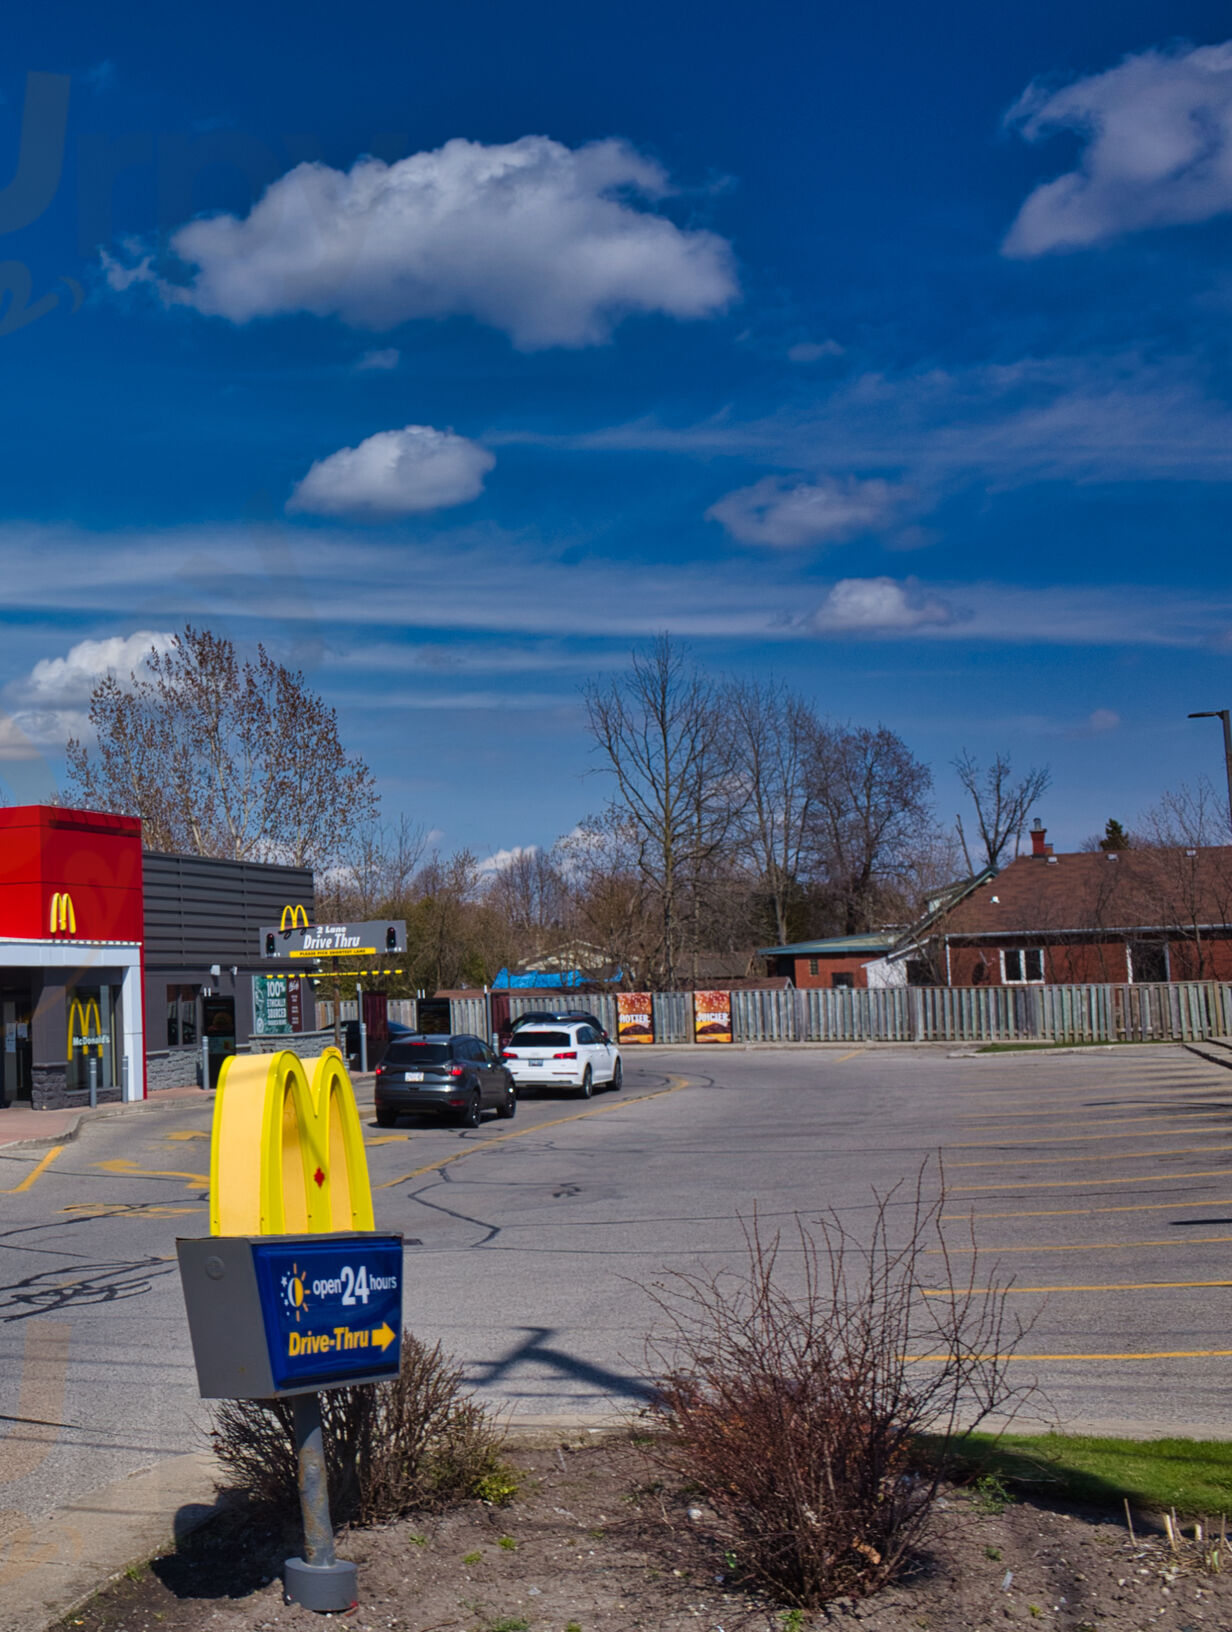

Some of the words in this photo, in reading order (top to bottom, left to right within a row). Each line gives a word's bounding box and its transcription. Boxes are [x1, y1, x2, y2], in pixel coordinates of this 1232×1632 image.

[316, 926, 323, 934] 2
[325, 925, 347, 934] Lane
[303, 934, 332, 950] Drive
[334, 933, 360, 948] Thru
[266, 981, 286, 998] 100%
[313, 1278, 342, 1299] open
[340, 1266, 370, 1306] 24
[369, 1274, 398, 1290] hours
[288, 1327, 369, 1357] Drive-Thru
